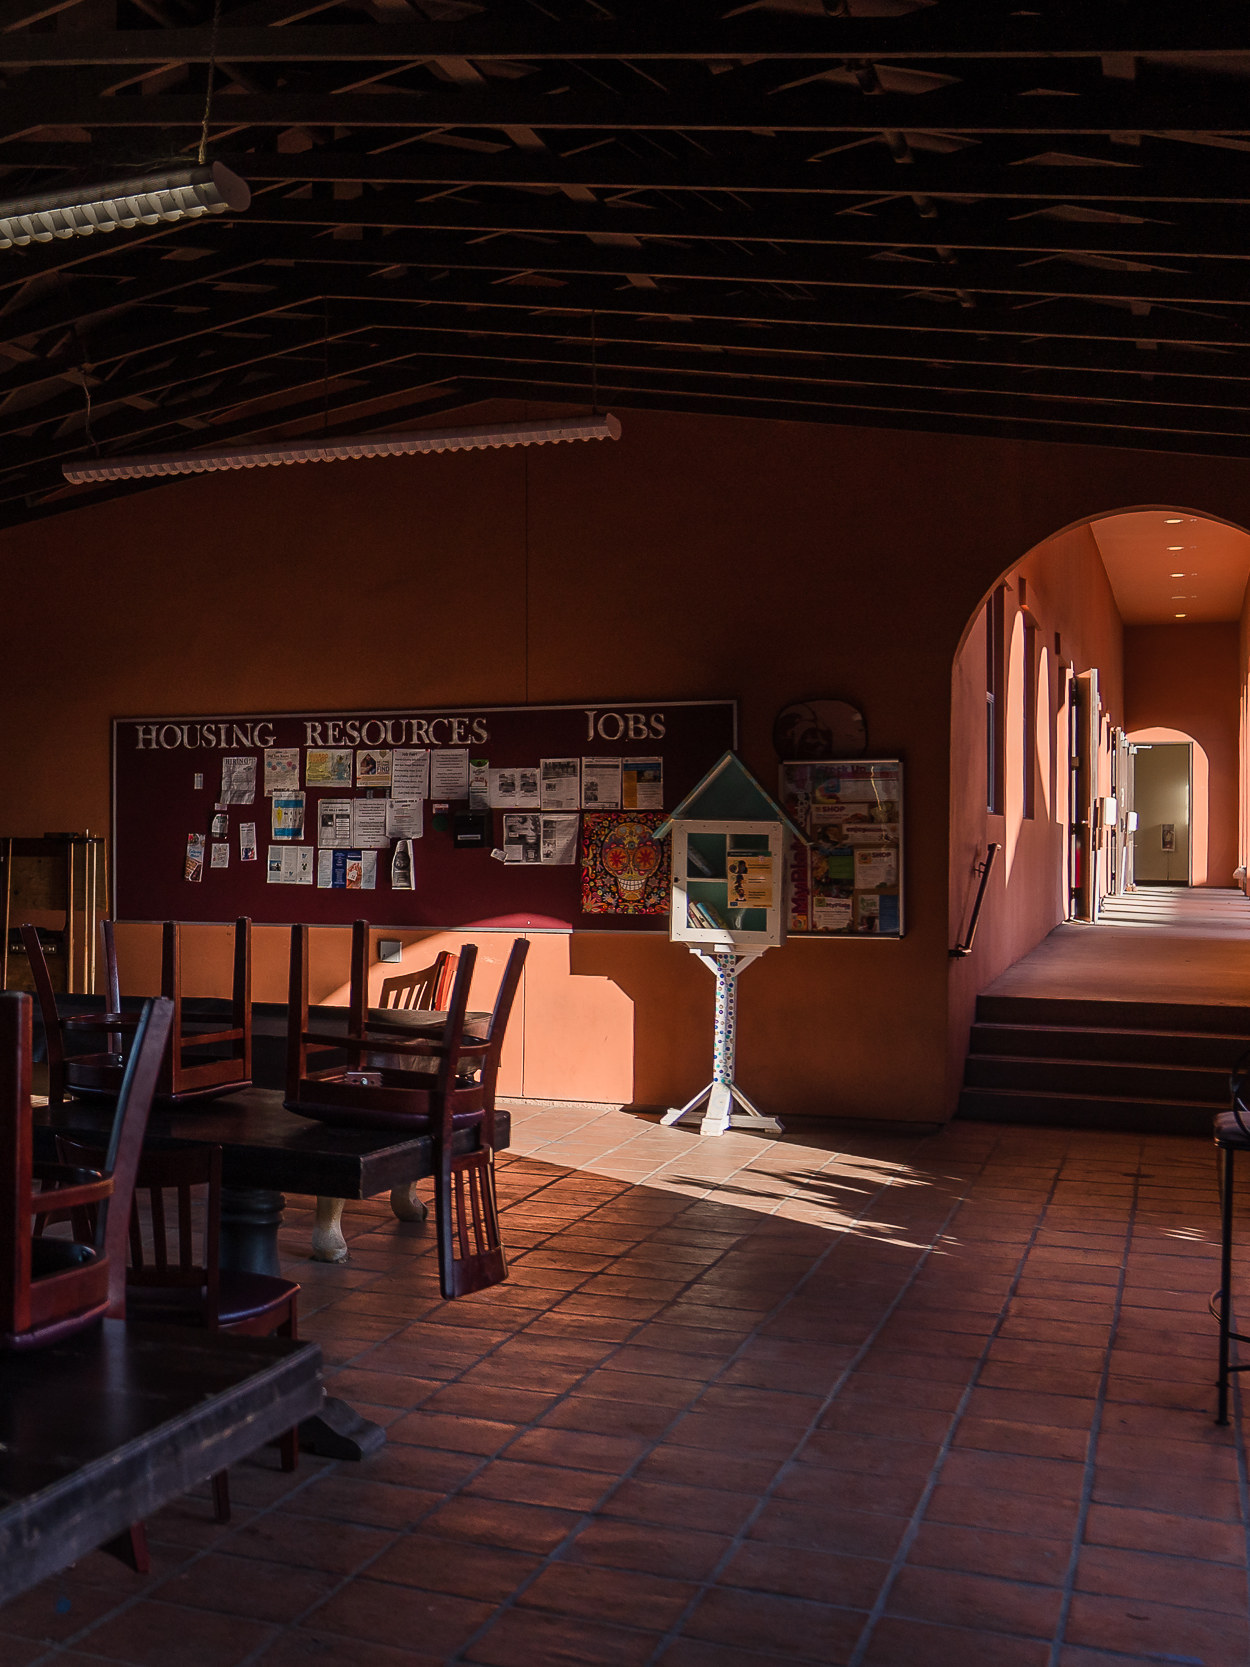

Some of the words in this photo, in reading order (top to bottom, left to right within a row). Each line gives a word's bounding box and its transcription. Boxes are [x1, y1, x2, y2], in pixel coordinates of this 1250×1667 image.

[135, 722, 277, 749] HOUSING
[303, 717, 489, 746] RESOURCES
[584, 710, 666, 742] JOBS
